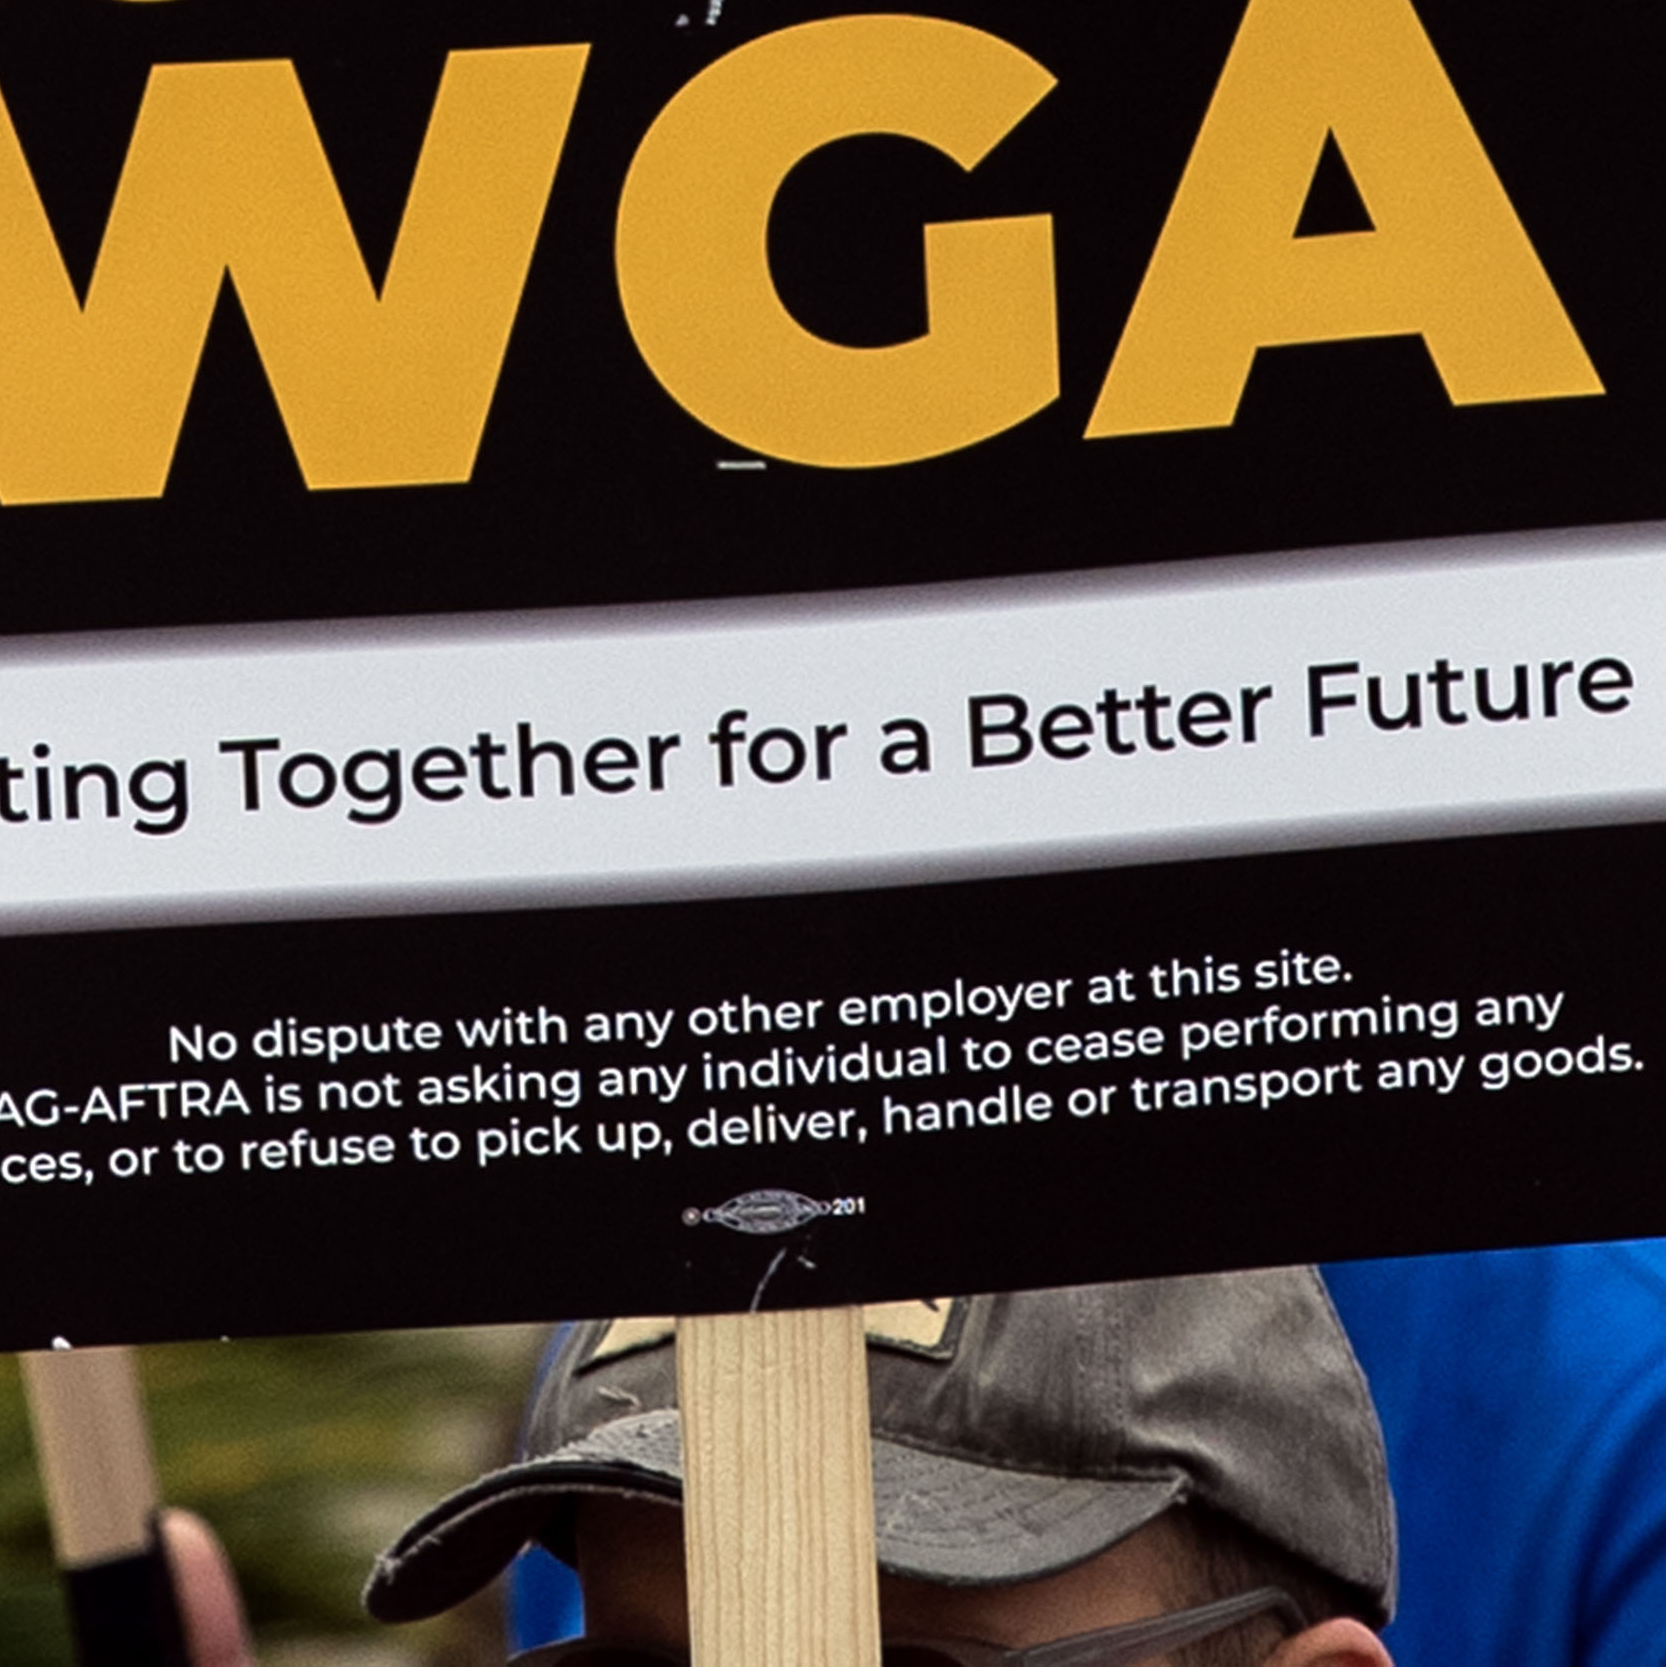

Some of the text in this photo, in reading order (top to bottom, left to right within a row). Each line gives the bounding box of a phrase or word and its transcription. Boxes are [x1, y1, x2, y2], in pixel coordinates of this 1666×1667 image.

[219, 722, 682, 825] Together
[708, 709, 848, 787] for
[879, 718, 931, 774] a
[968, 685, 1273, 769] Better
[1308, 658, 1634, 737] Future
[169, 948, 1353, 1064] No dispute with any other employer at this site.
[264, 1073, 303, 1114] is
[318, 1072, 403, 1111] not
[417, 1061, 581, 1108] asking
[598, 1063, 688, 1104] any
[702, 1035, 947, 1092] individual
[961, 1037, 1012, 1072] to
[1026, 1026, 1165, 1066] cease
[1180, 994, 1459, 1061] performing
[1475, 991, 1565, 1032] any
[108, 1146, 160, 1178] or
[172, 1139, 225, 1174] to
[241, 1127, 396, 1170] refuse
[408, 1127, 461, 1162] to
[477, 1115, 582, 1167] pick
[597, 1121, 673, 1160] up,
[687, 1103, 868, 1148] deliver,
[883, 1084, 1053, 1135] handle
[1067, 1085, 1118, 1118] or
[1130, 1058, 1363, 1112] transport
[1377, 1054, 1466, 1095] any
[1479, 1034, 1644, 1091] goods.
[832, 1197, 866, 1216] 201
